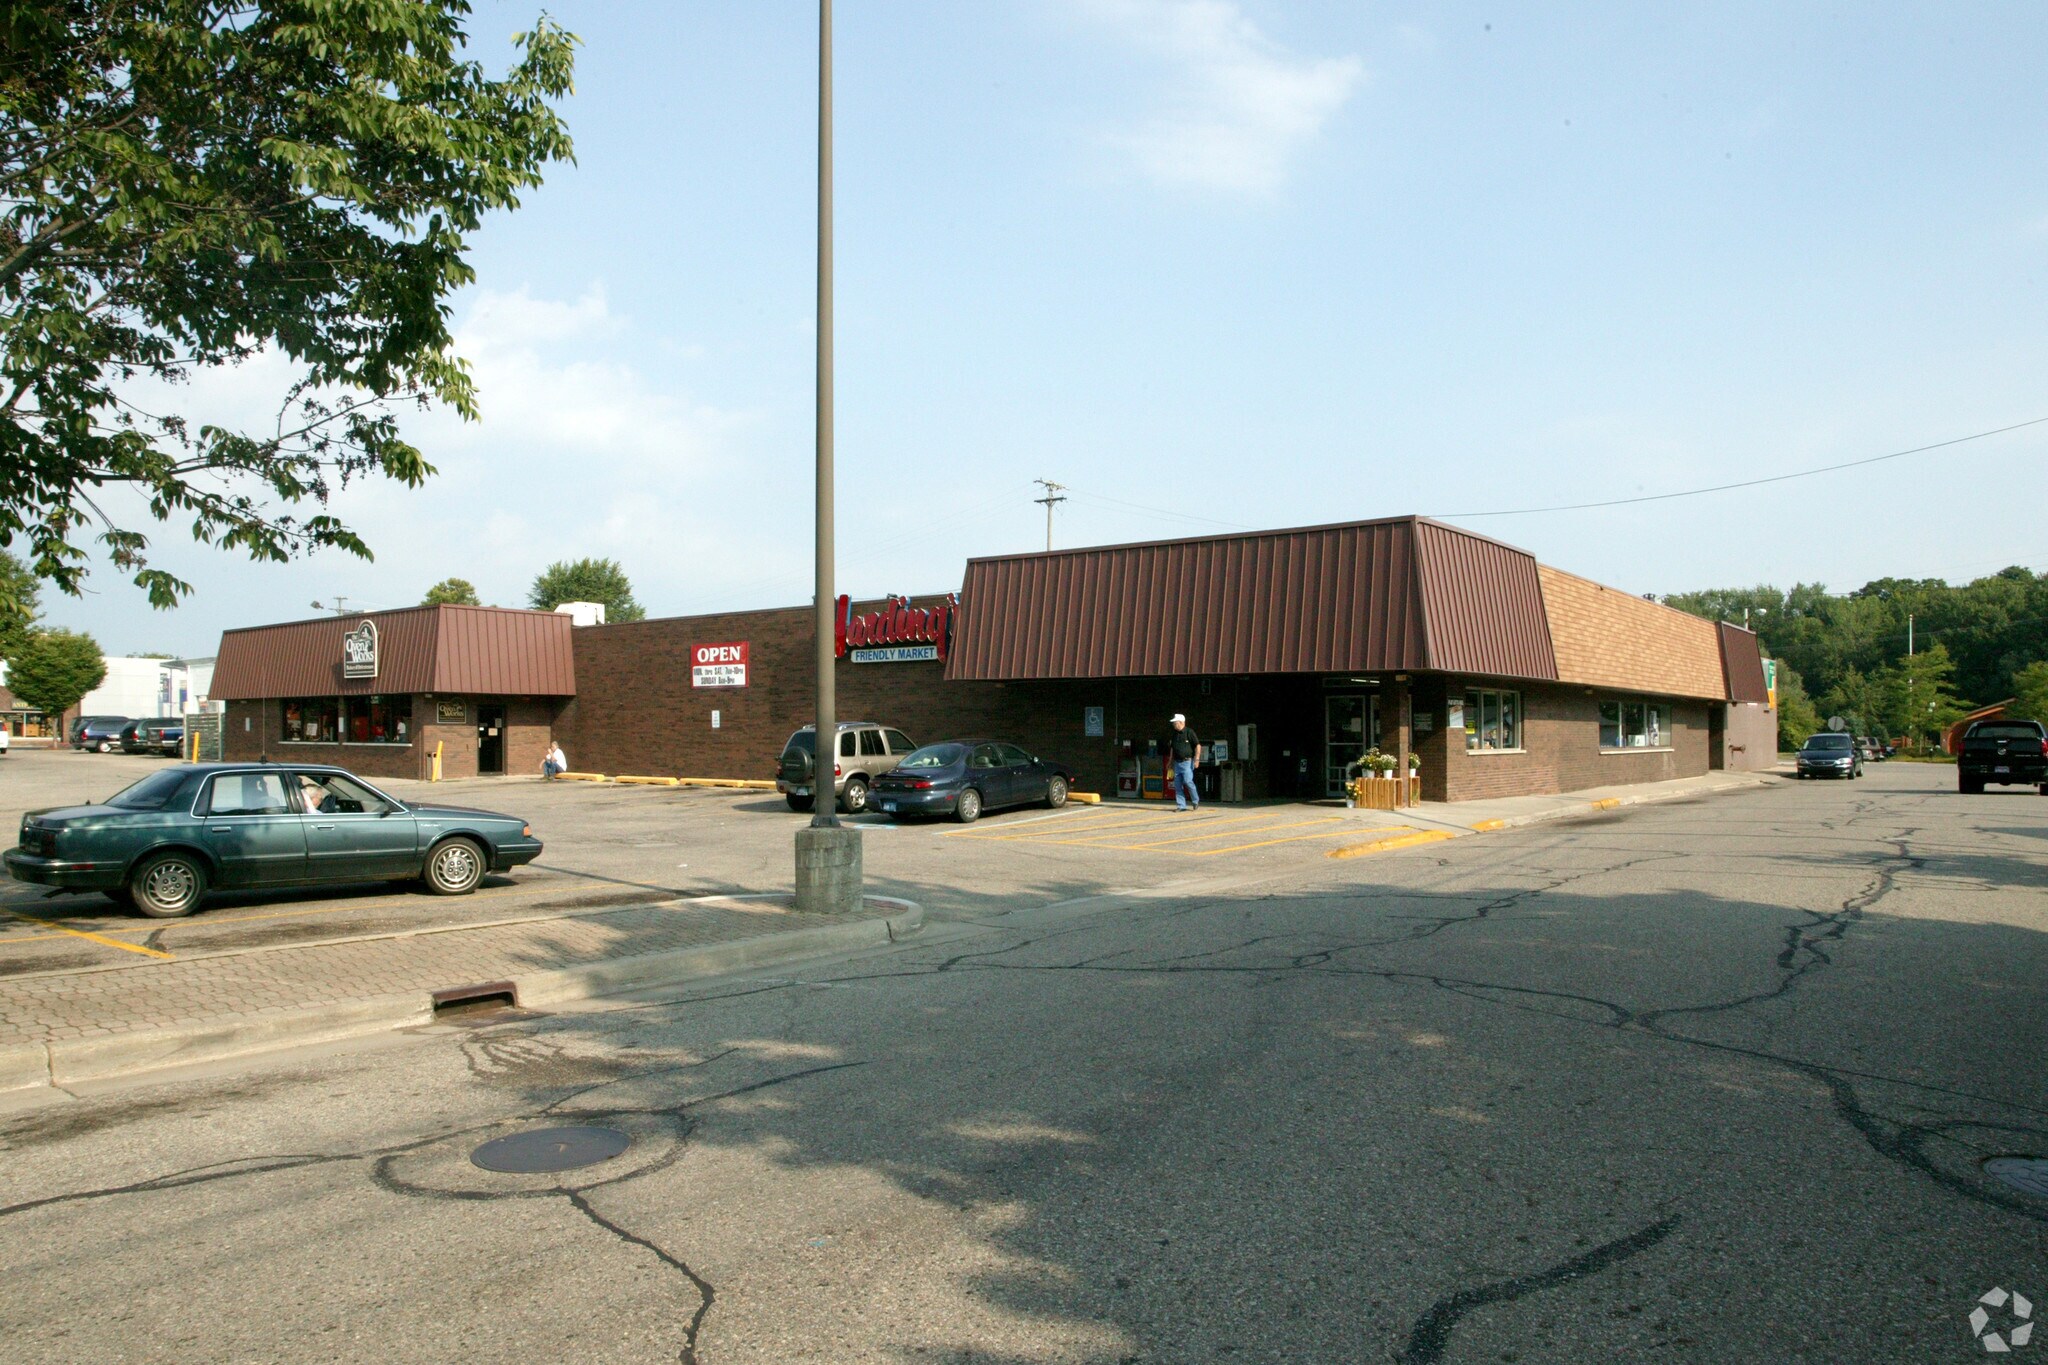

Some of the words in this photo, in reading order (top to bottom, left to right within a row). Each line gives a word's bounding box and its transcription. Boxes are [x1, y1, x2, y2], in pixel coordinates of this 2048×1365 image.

[697, 646, 741, 663] OPEN
[855, 649, 896, 661] FRIENDLY
[898, 647, 935, 659] MARKET
[701, 676, 717, 684] SUNDAY
